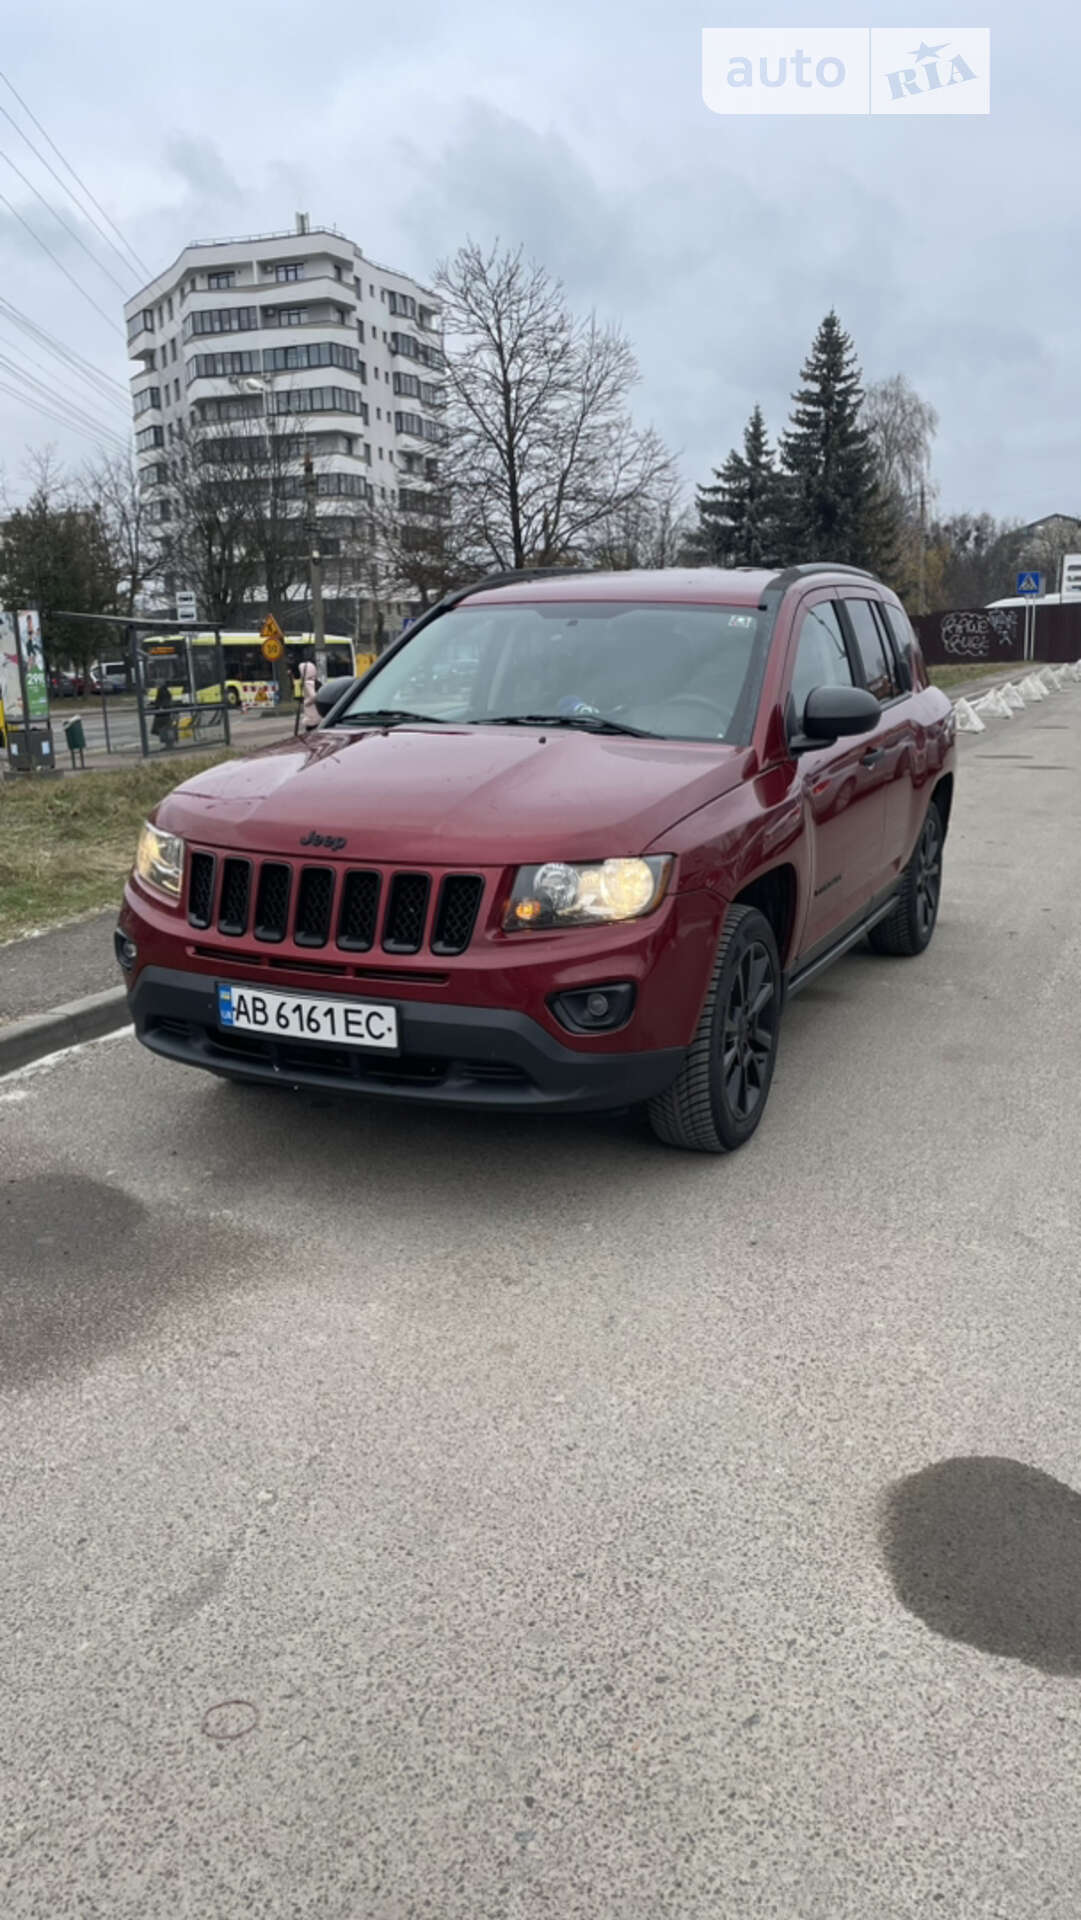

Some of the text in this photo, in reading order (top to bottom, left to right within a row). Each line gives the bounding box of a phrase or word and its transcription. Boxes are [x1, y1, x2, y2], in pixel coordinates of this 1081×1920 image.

[300, 831, 347, 852] Jeep
[236, 994, 386, 1040] AB 6161 EC
